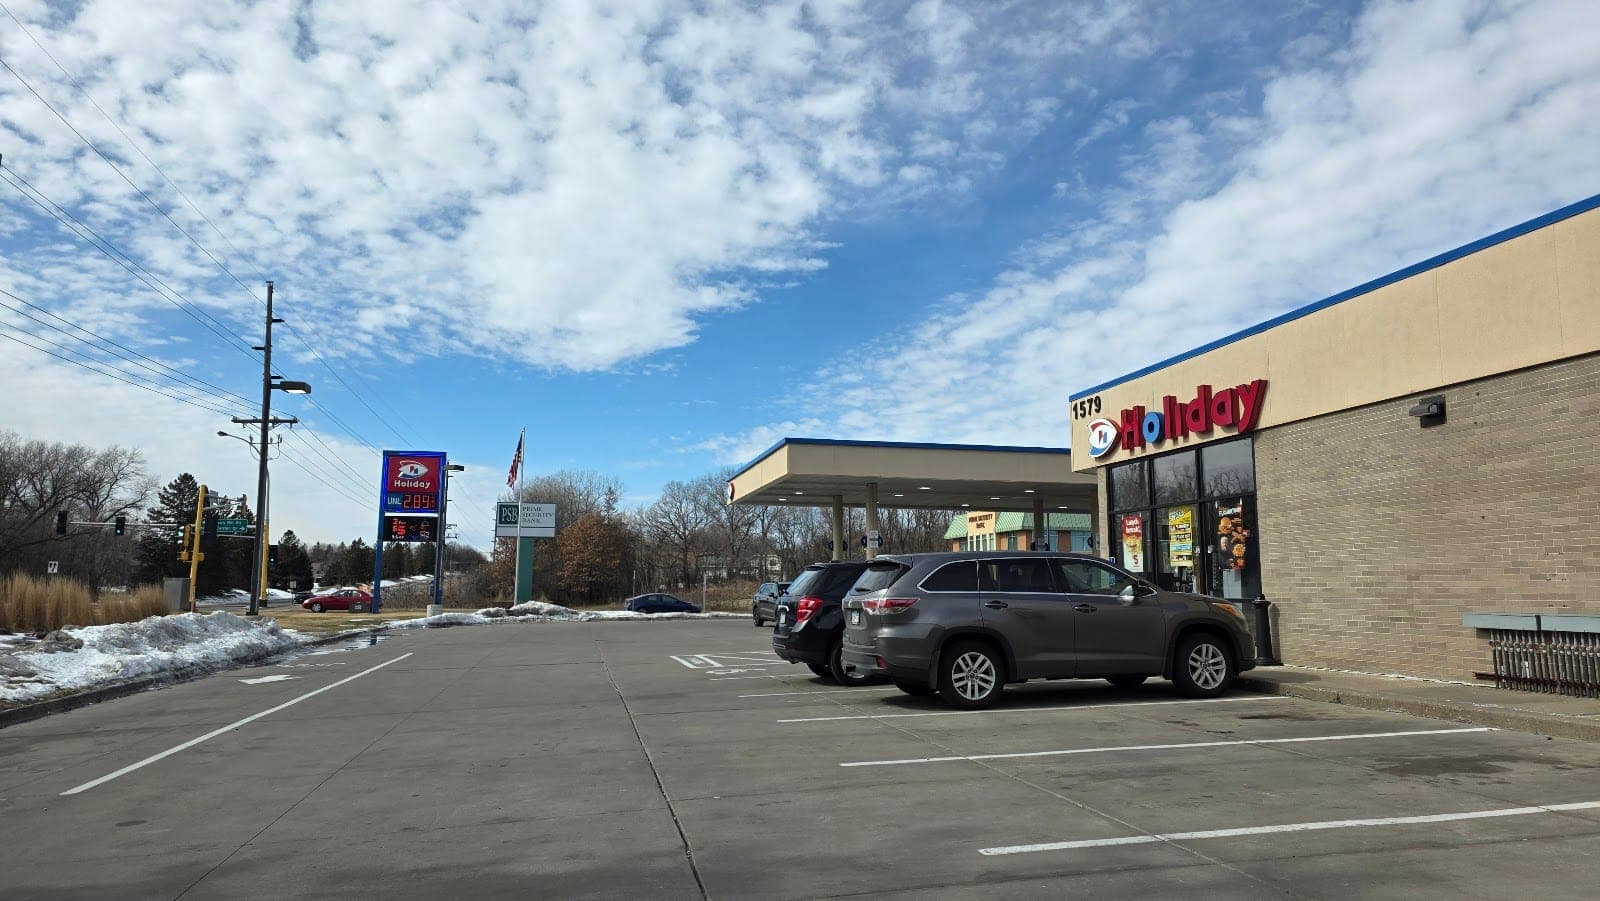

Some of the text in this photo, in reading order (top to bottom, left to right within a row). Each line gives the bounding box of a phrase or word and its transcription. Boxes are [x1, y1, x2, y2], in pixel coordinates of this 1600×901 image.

[1073, 396, 1102, 420] 1579
[1121, 379, 1268, 450] Holiday
[394, 479, 431, 489] Holiday
[387, 497, 403, 505] UNL
[502, 507, 519, 522] PSB
